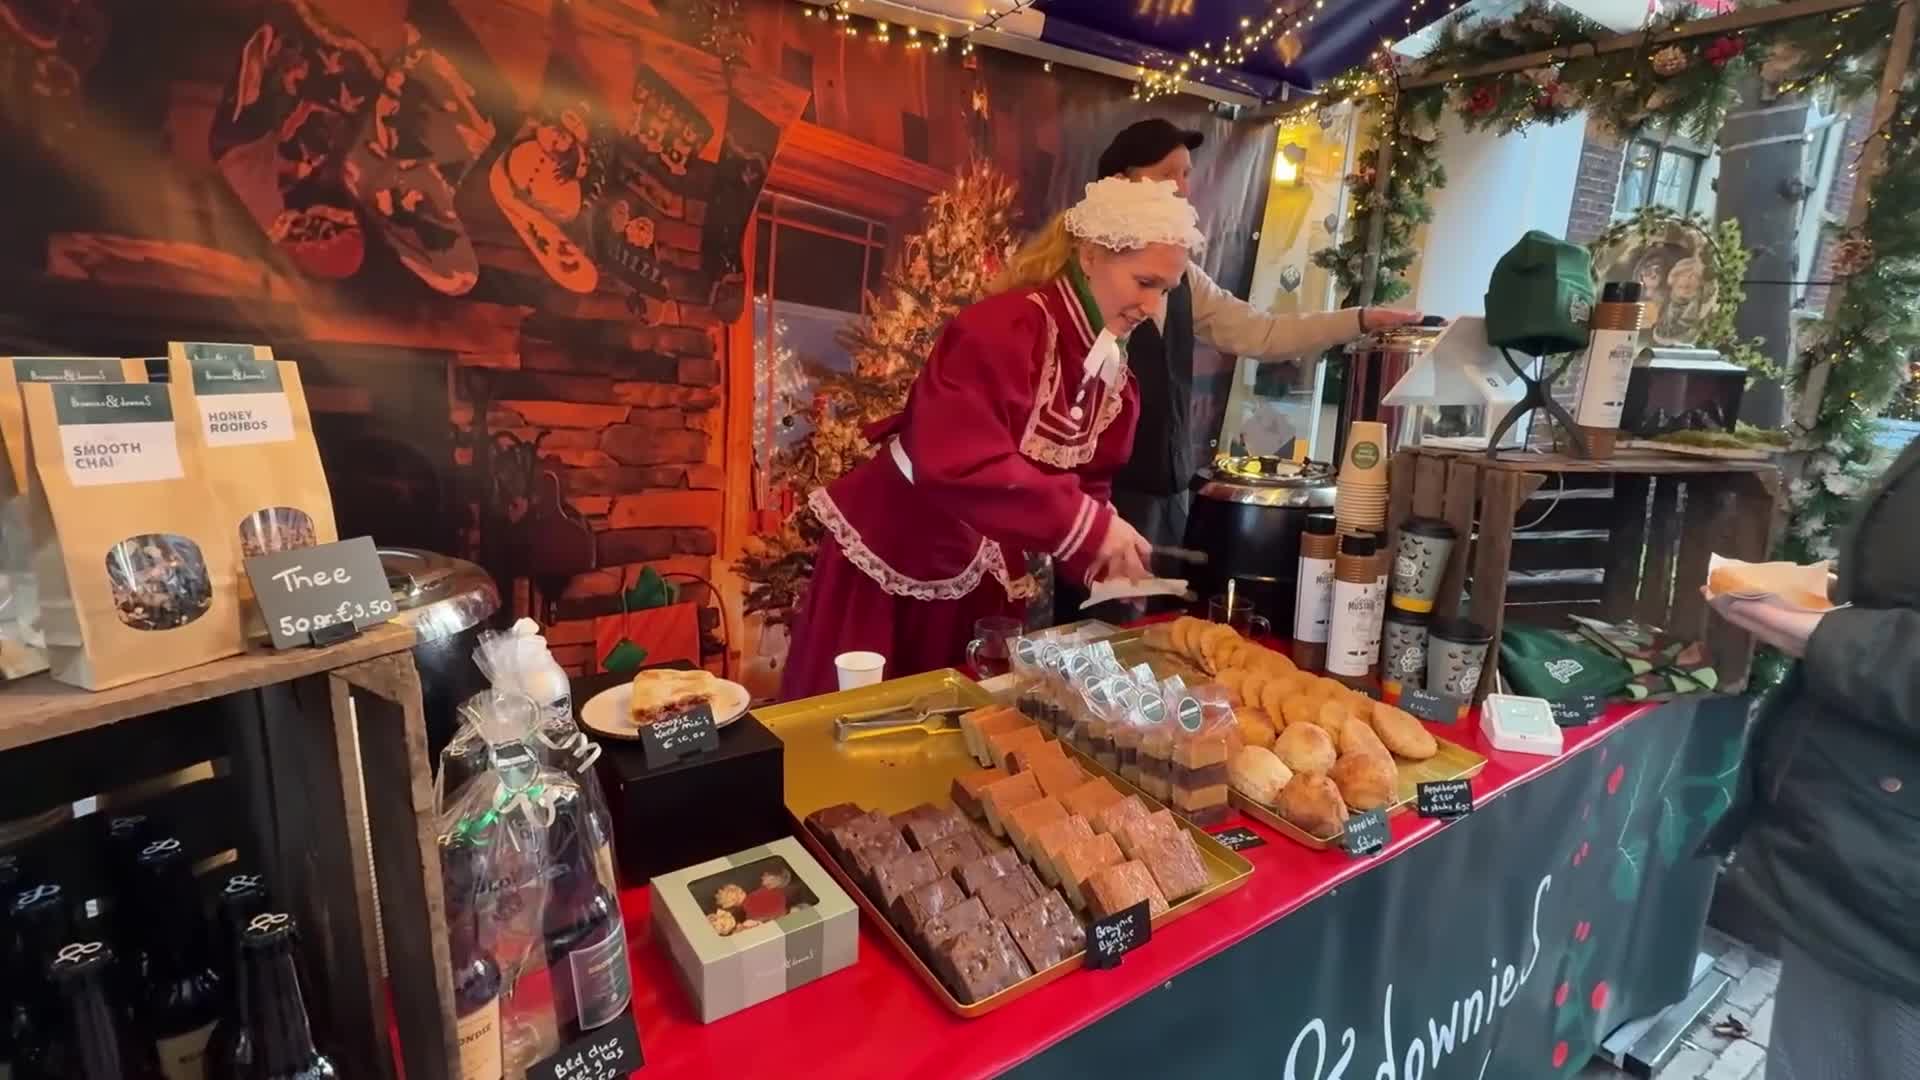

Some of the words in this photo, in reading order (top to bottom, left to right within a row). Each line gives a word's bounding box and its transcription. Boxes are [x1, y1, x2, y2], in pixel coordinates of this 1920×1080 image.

[208, 410, 252, 421] HONEY
[210, 420, 268, 433] ROOIBOS
[73, 443, 142, 457] SMOOTH
[75, 457, 114, 469] CHAI
[271, 565, 351, 593] Thee
